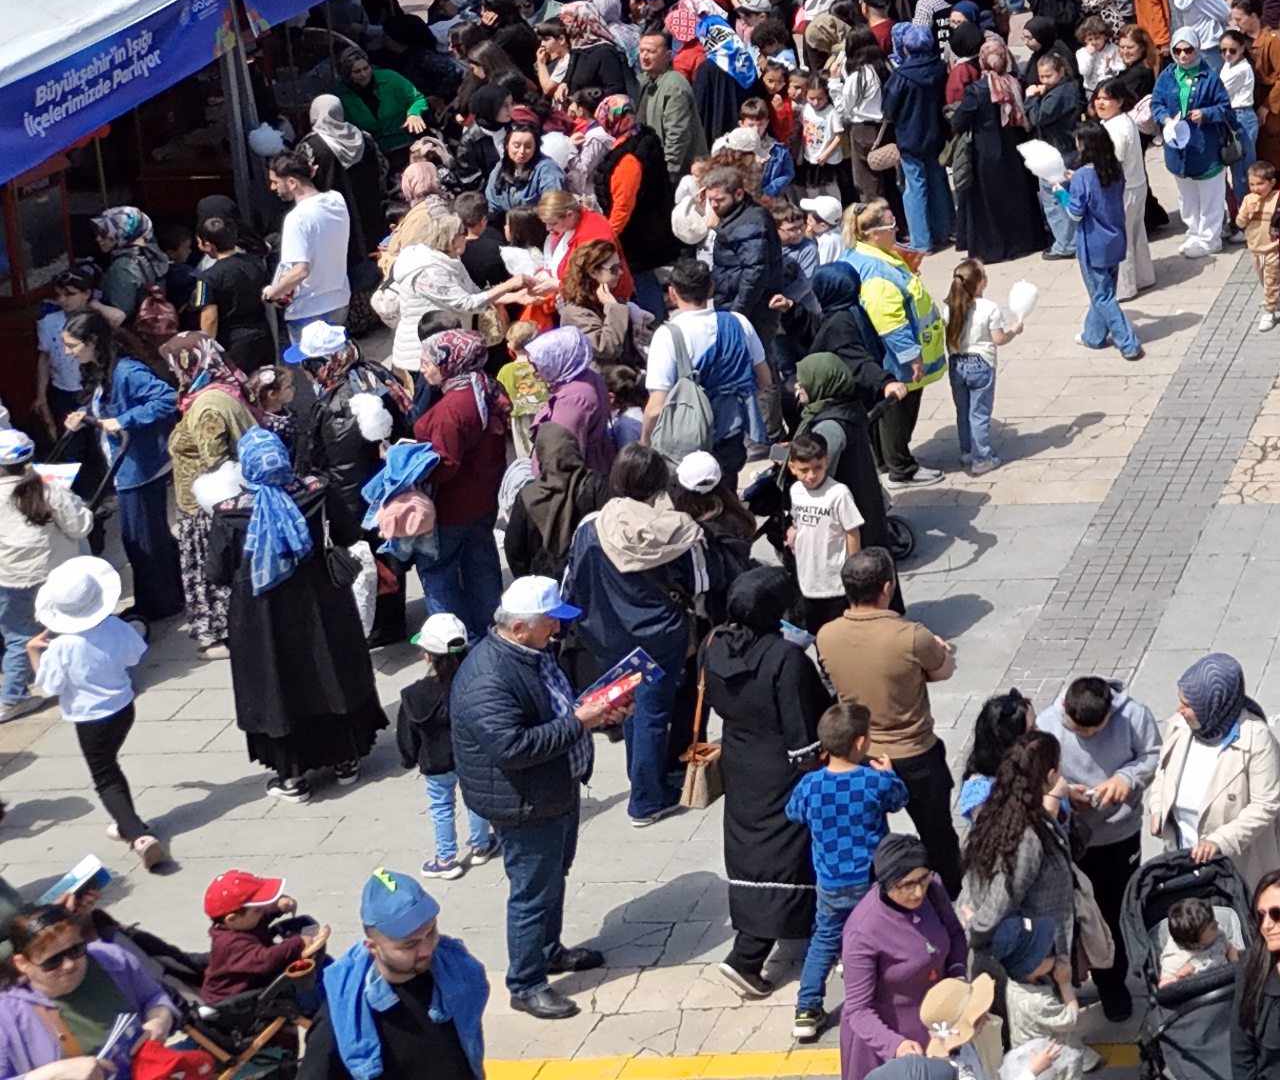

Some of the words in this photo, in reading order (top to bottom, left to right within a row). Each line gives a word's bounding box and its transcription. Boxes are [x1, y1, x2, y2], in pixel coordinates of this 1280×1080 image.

[23, 77, 111, 138] İlçelerimizde
[112, 48, 162, 89] Parlıyor
[35, 46, 126, 108] Büyükşehir'in
